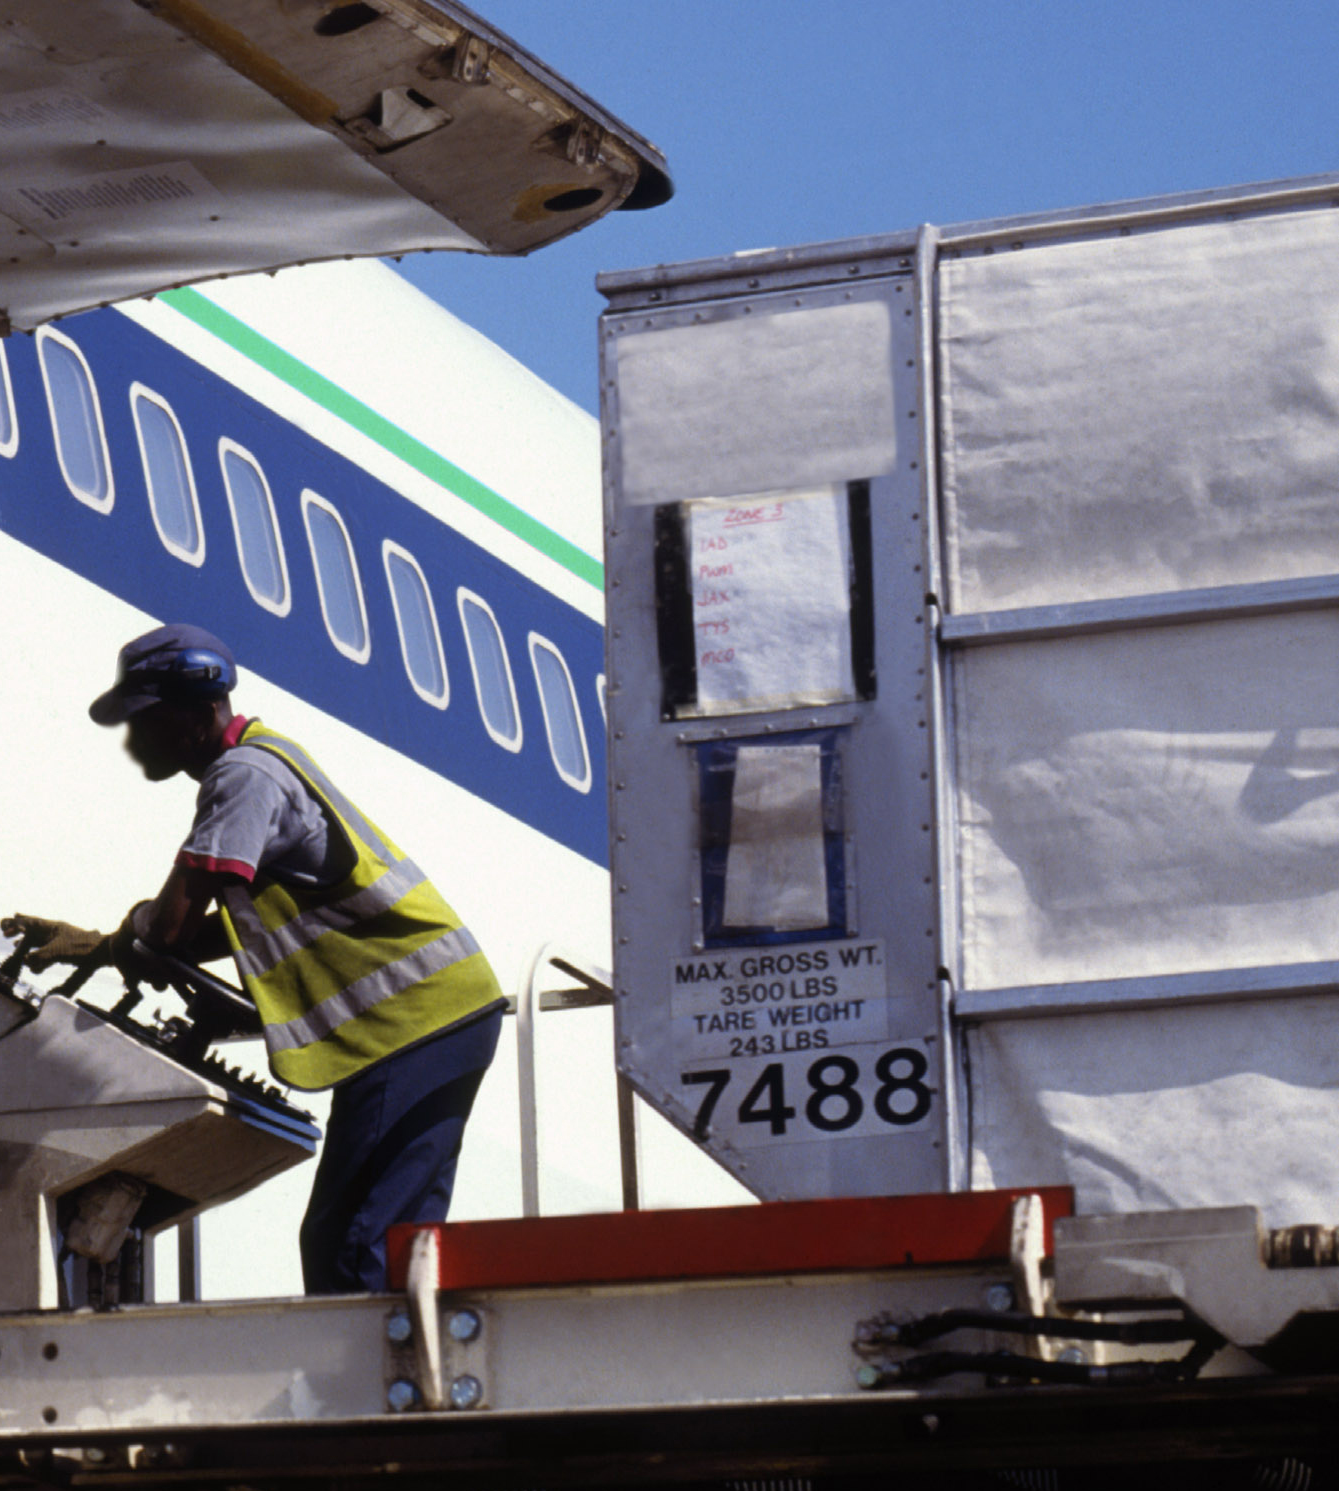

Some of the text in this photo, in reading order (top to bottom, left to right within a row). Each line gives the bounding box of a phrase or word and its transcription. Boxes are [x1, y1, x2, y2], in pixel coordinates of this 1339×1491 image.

[697, 589, 730, 607] JAX
[675, 946, 883, 984] MAX. GROSS WT.
[721, 976, 838, 1006] 3500 LBS
[693, 1000, 865, 1034] TARE WEIGHT
[729, 1030, 829, 1057] 243 LBS
[681, 1047, 932, 1143] 7488
